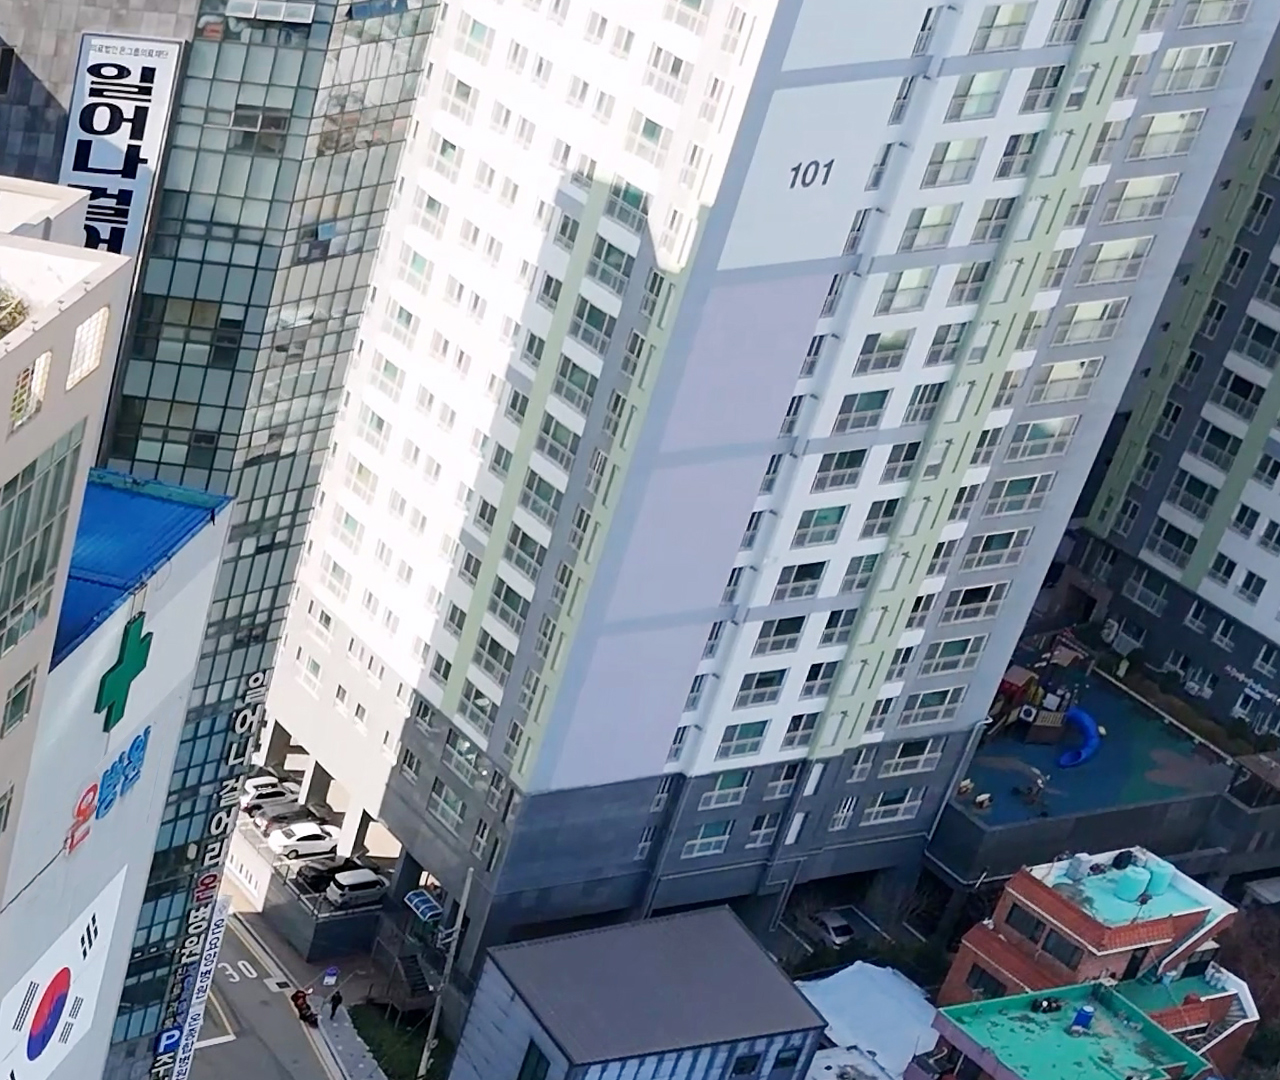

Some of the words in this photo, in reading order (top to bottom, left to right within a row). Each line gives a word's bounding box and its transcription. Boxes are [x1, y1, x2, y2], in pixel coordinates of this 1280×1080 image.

[787, 159, 835, 191] 101
[67, 725, 152, 858] 온병원
[217, 959, 258, 983] 30
[160, 1029, 181, 1053] P
